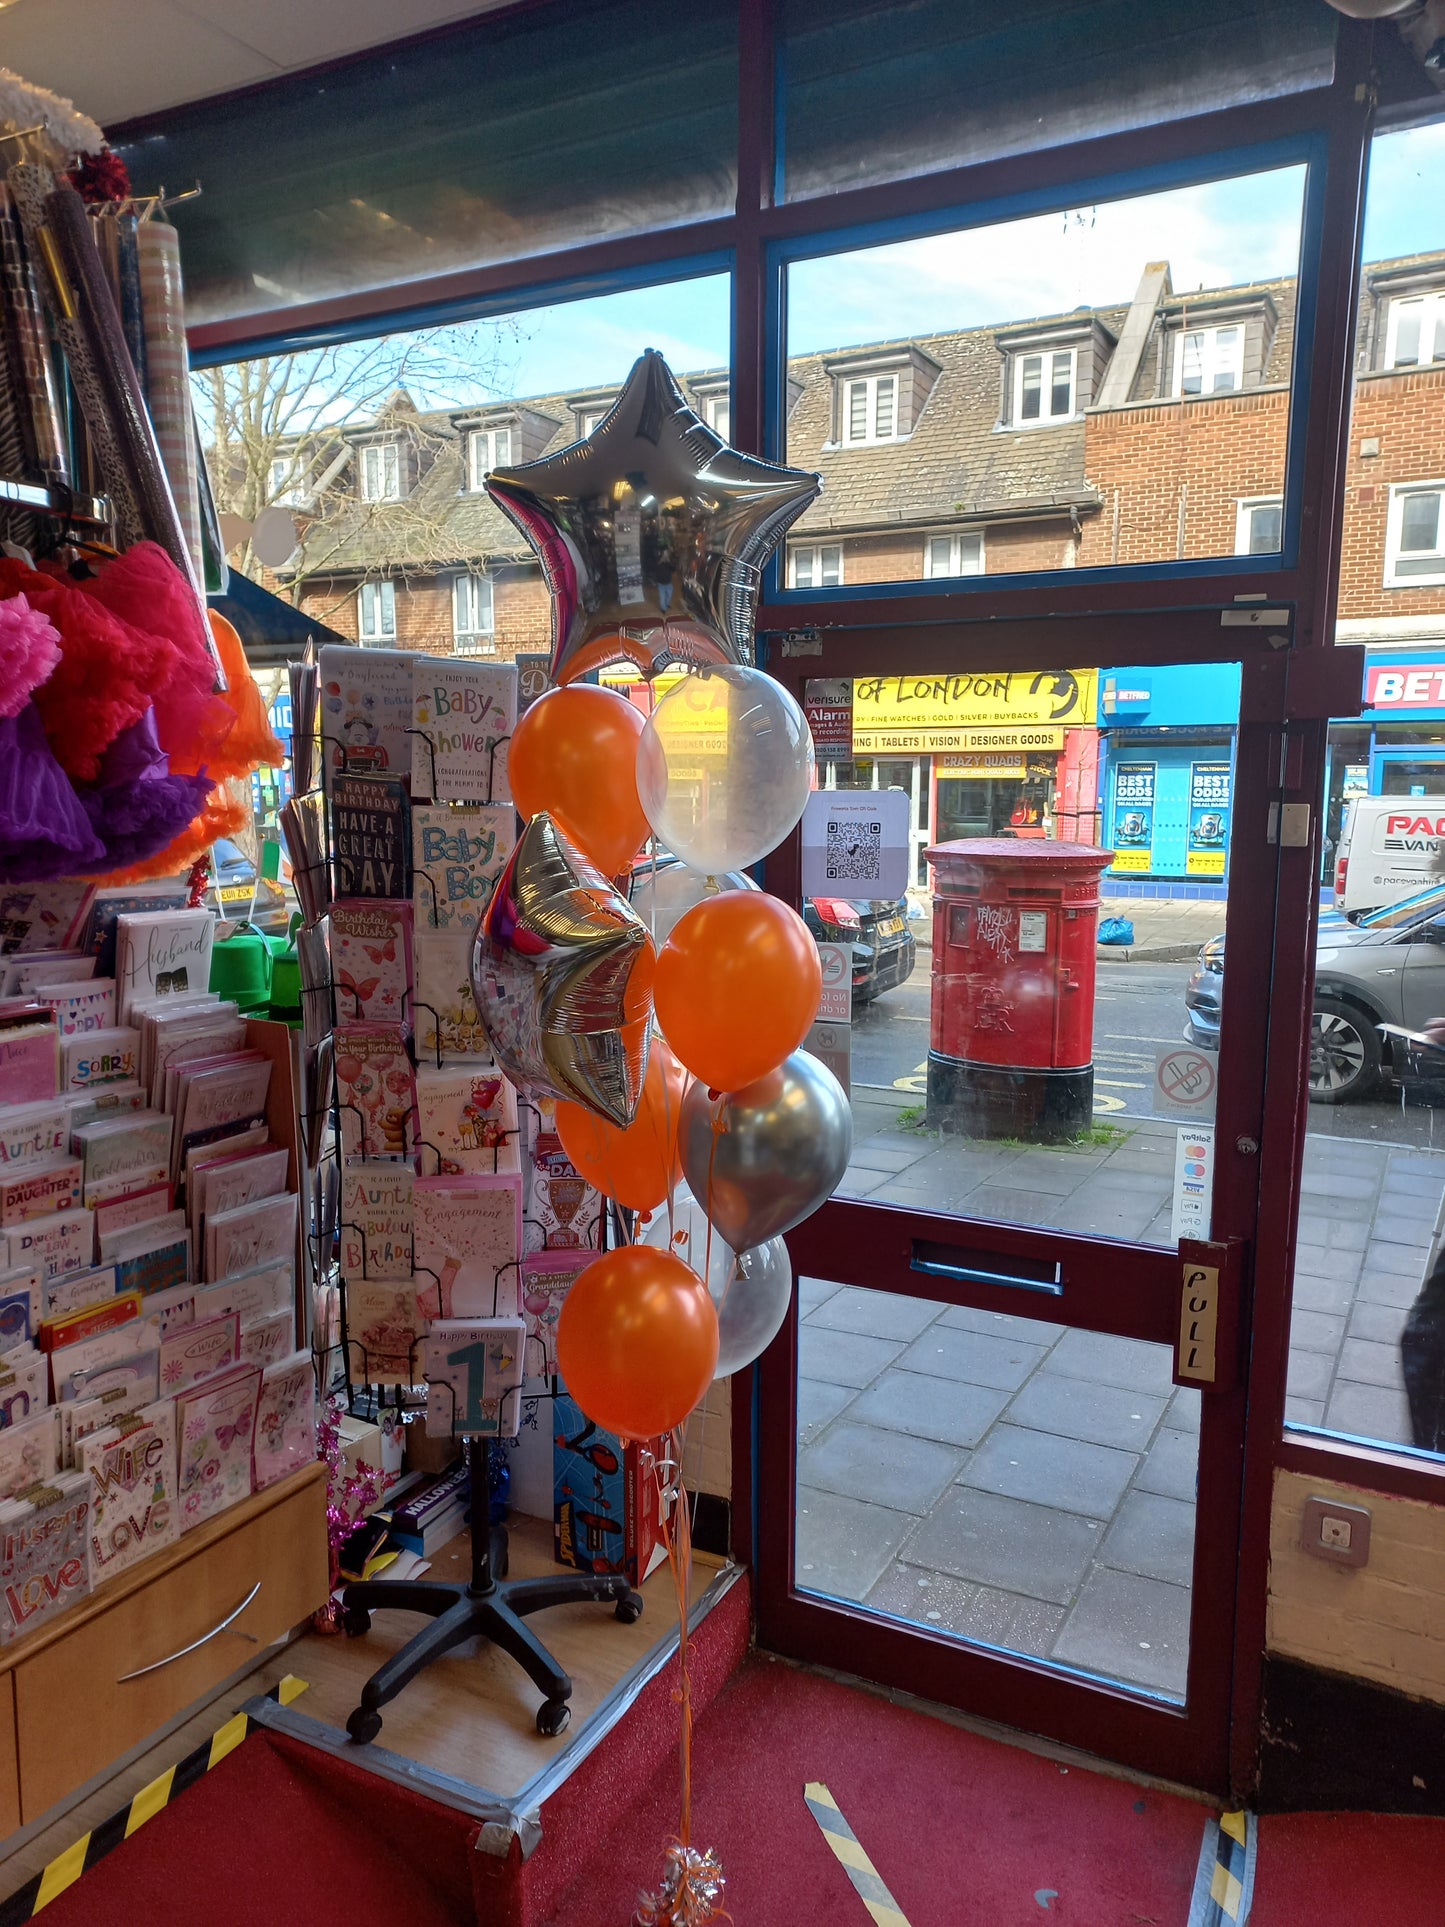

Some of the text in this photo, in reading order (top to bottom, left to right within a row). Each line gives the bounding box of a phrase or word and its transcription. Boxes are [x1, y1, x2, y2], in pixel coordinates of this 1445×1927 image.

[857, 673, 1012, 705] OF LONDON
[807, 694, 851, 706] verisure
[808, 709, 851, 721] Alarm
[960, 713, 987, 721] SILVER
[994, 712, 1039, 720] BUYBACKS
[881, 737, 919, 748] TABLETS
[929, 736, 960, 746] VISION
[970, 735, 1018, 746] DESIGNER
[1020, 734, 1054, 744] GOODS
[943, 755, 1021, 768] CRAZY QUADS
[1029, 764, 1052, 776] STOCK
[1117, 774, 1154, 787] BEST
[1193, 775, 1230, 787] BEST
[345, 783, 386, 797] HAPPY
[1117, 787, 1153, 797] ODDS
[1192, 787, 1230, 798] ODDS
[335, 793, 399, 811] BIRTHDAY
[339, 811, 394, 835] HAVE A
[338, 833, 395, 860] GREAT
[422, 826, 496, 866] Baby
[340, 857, 395, 896] DAY
[332, 908, 390, 930] Birthday
[345, 922, 395, 938] Wishes
[126, 919, 209, 989] Husband
[337, 1043, 402, 1055] On Your Birthday
[418, 1089, 464, 1104] Engagement
[551, 1164, 579, 1177] DA
[6, 1178, 71, 1207] DAUGHTER
[344, 1183, 414, 1209] Aunti
[424, 1207, 501, 1225] Engagement
[1187, 1271, 1207, 1369] PULL
[439, 1331, 508, 1342] Happy Birthday
[447, 1341, 499, 1432] 1
